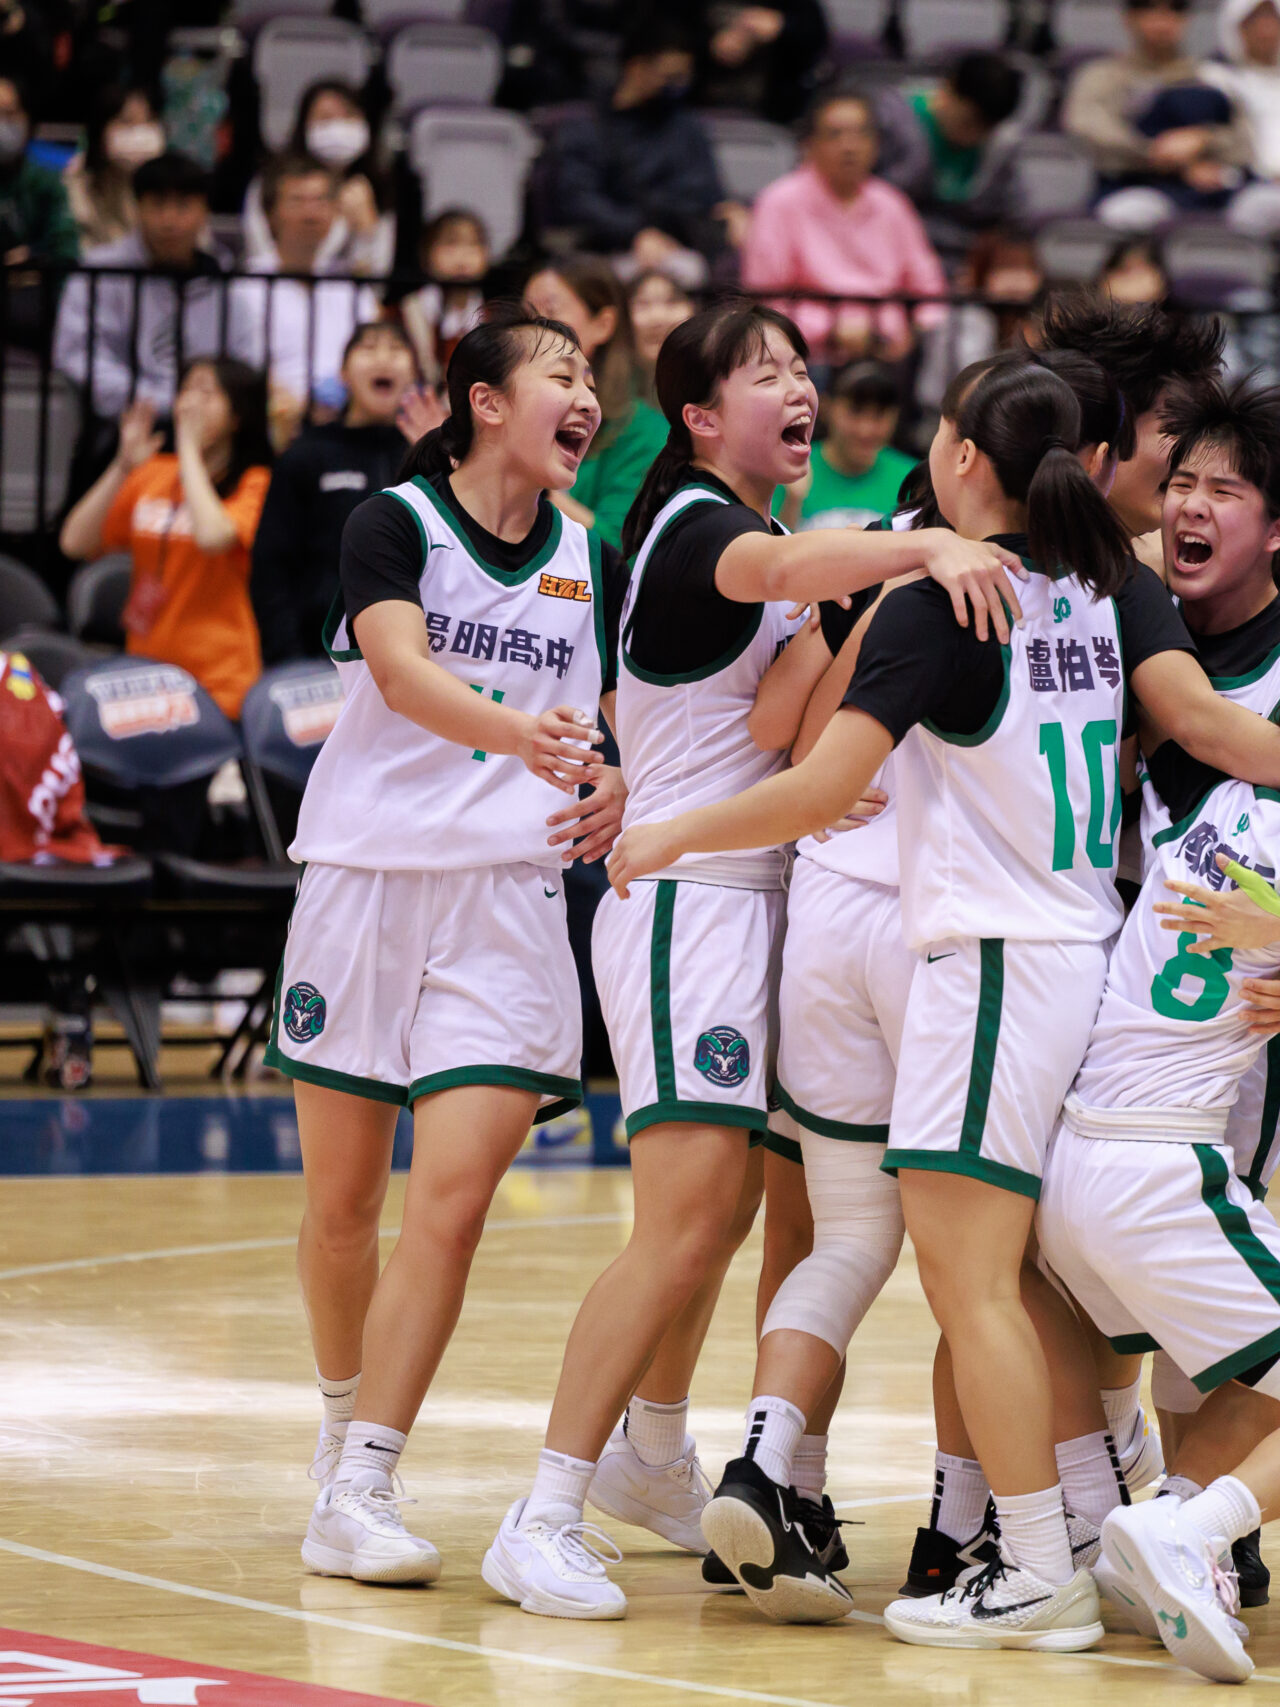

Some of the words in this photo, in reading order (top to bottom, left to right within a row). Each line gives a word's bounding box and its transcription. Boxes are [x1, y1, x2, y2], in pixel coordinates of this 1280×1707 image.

[537, 573, 592, 602] HBL
[1025, 636, 1121, 693] 盧柏岑
[1039, 719, 1123, 872] 10
